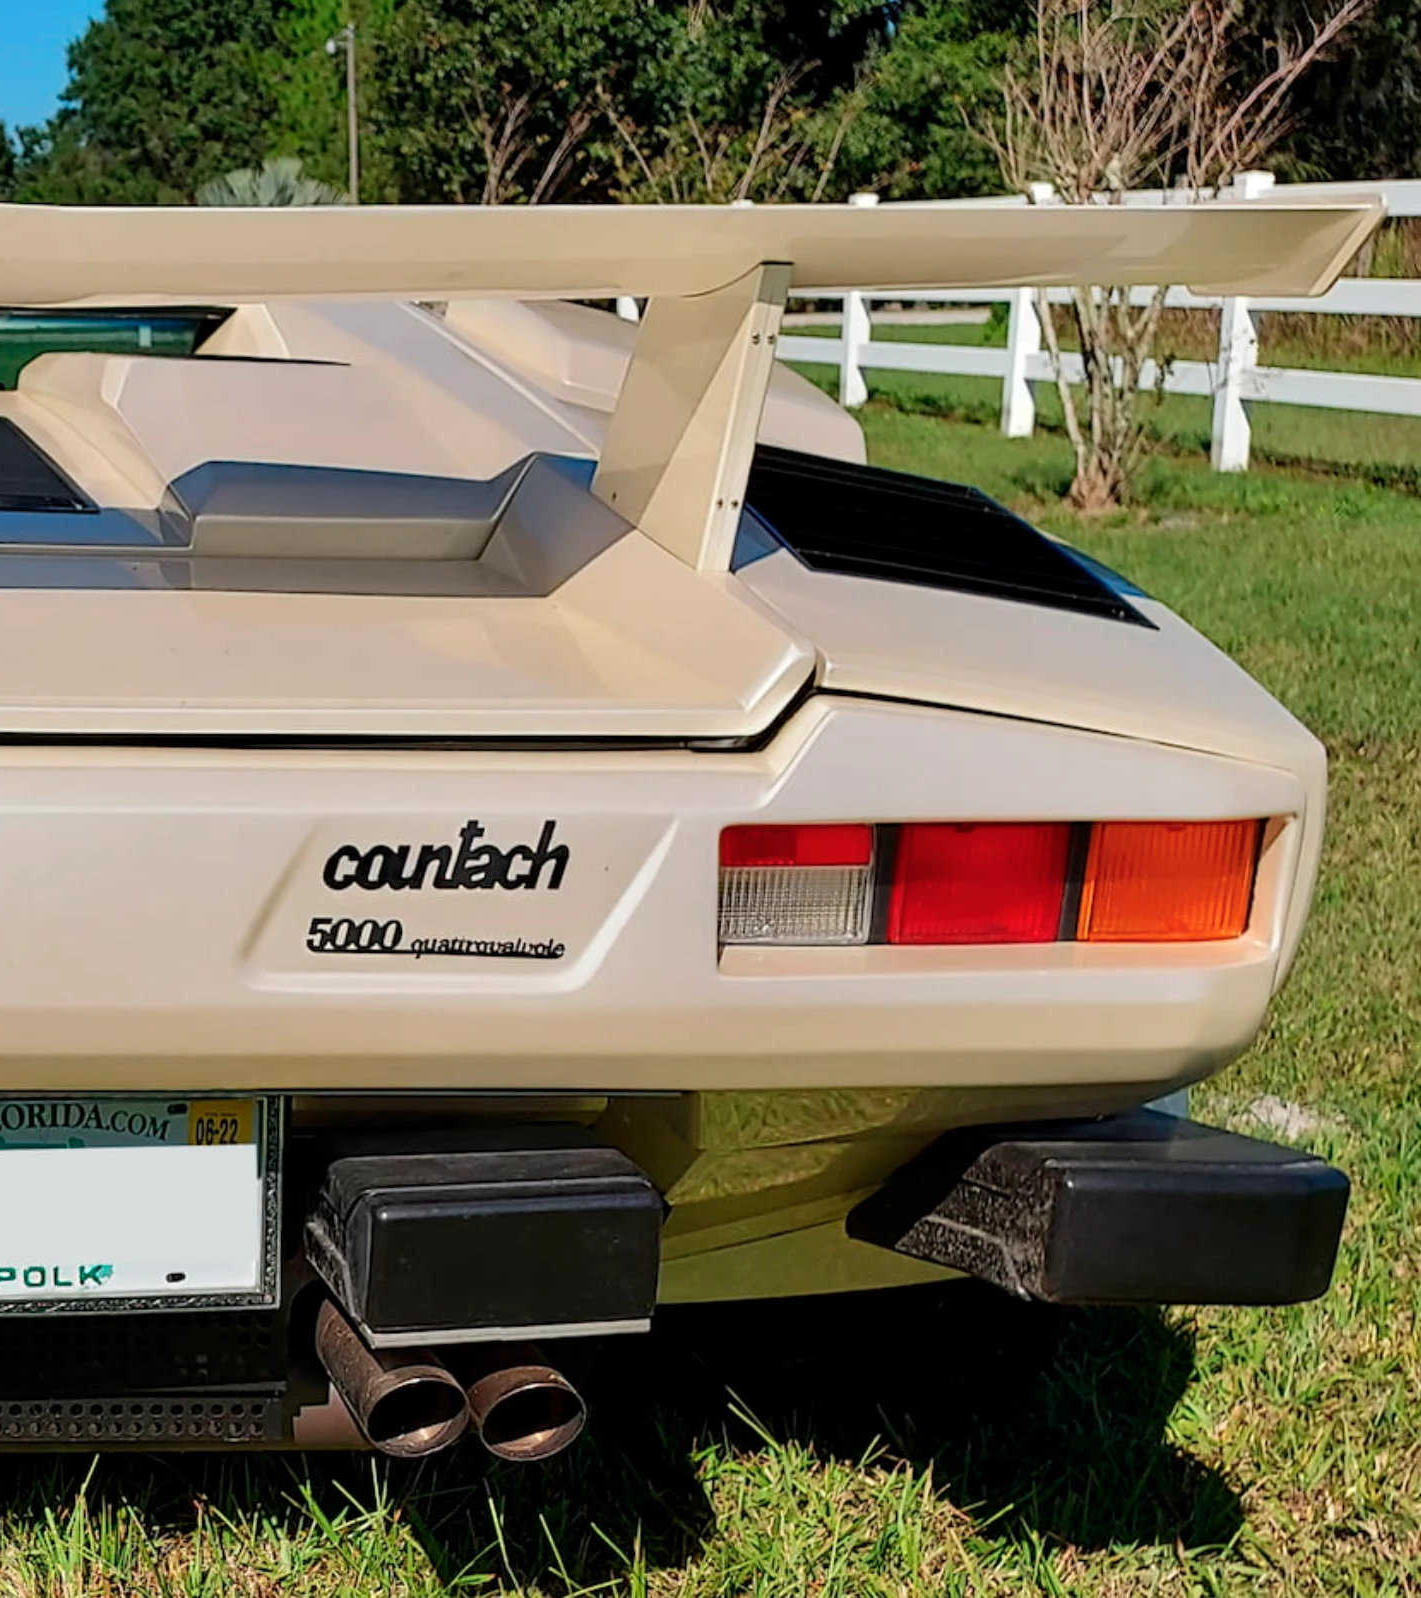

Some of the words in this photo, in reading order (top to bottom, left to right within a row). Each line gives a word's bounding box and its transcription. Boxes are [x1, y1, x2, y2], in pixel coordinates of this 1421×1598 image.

[323, 819, 570, 890] countach
[307, 917, 403, 952] 5000
[196, 1117, 239, 1146] 06-22
